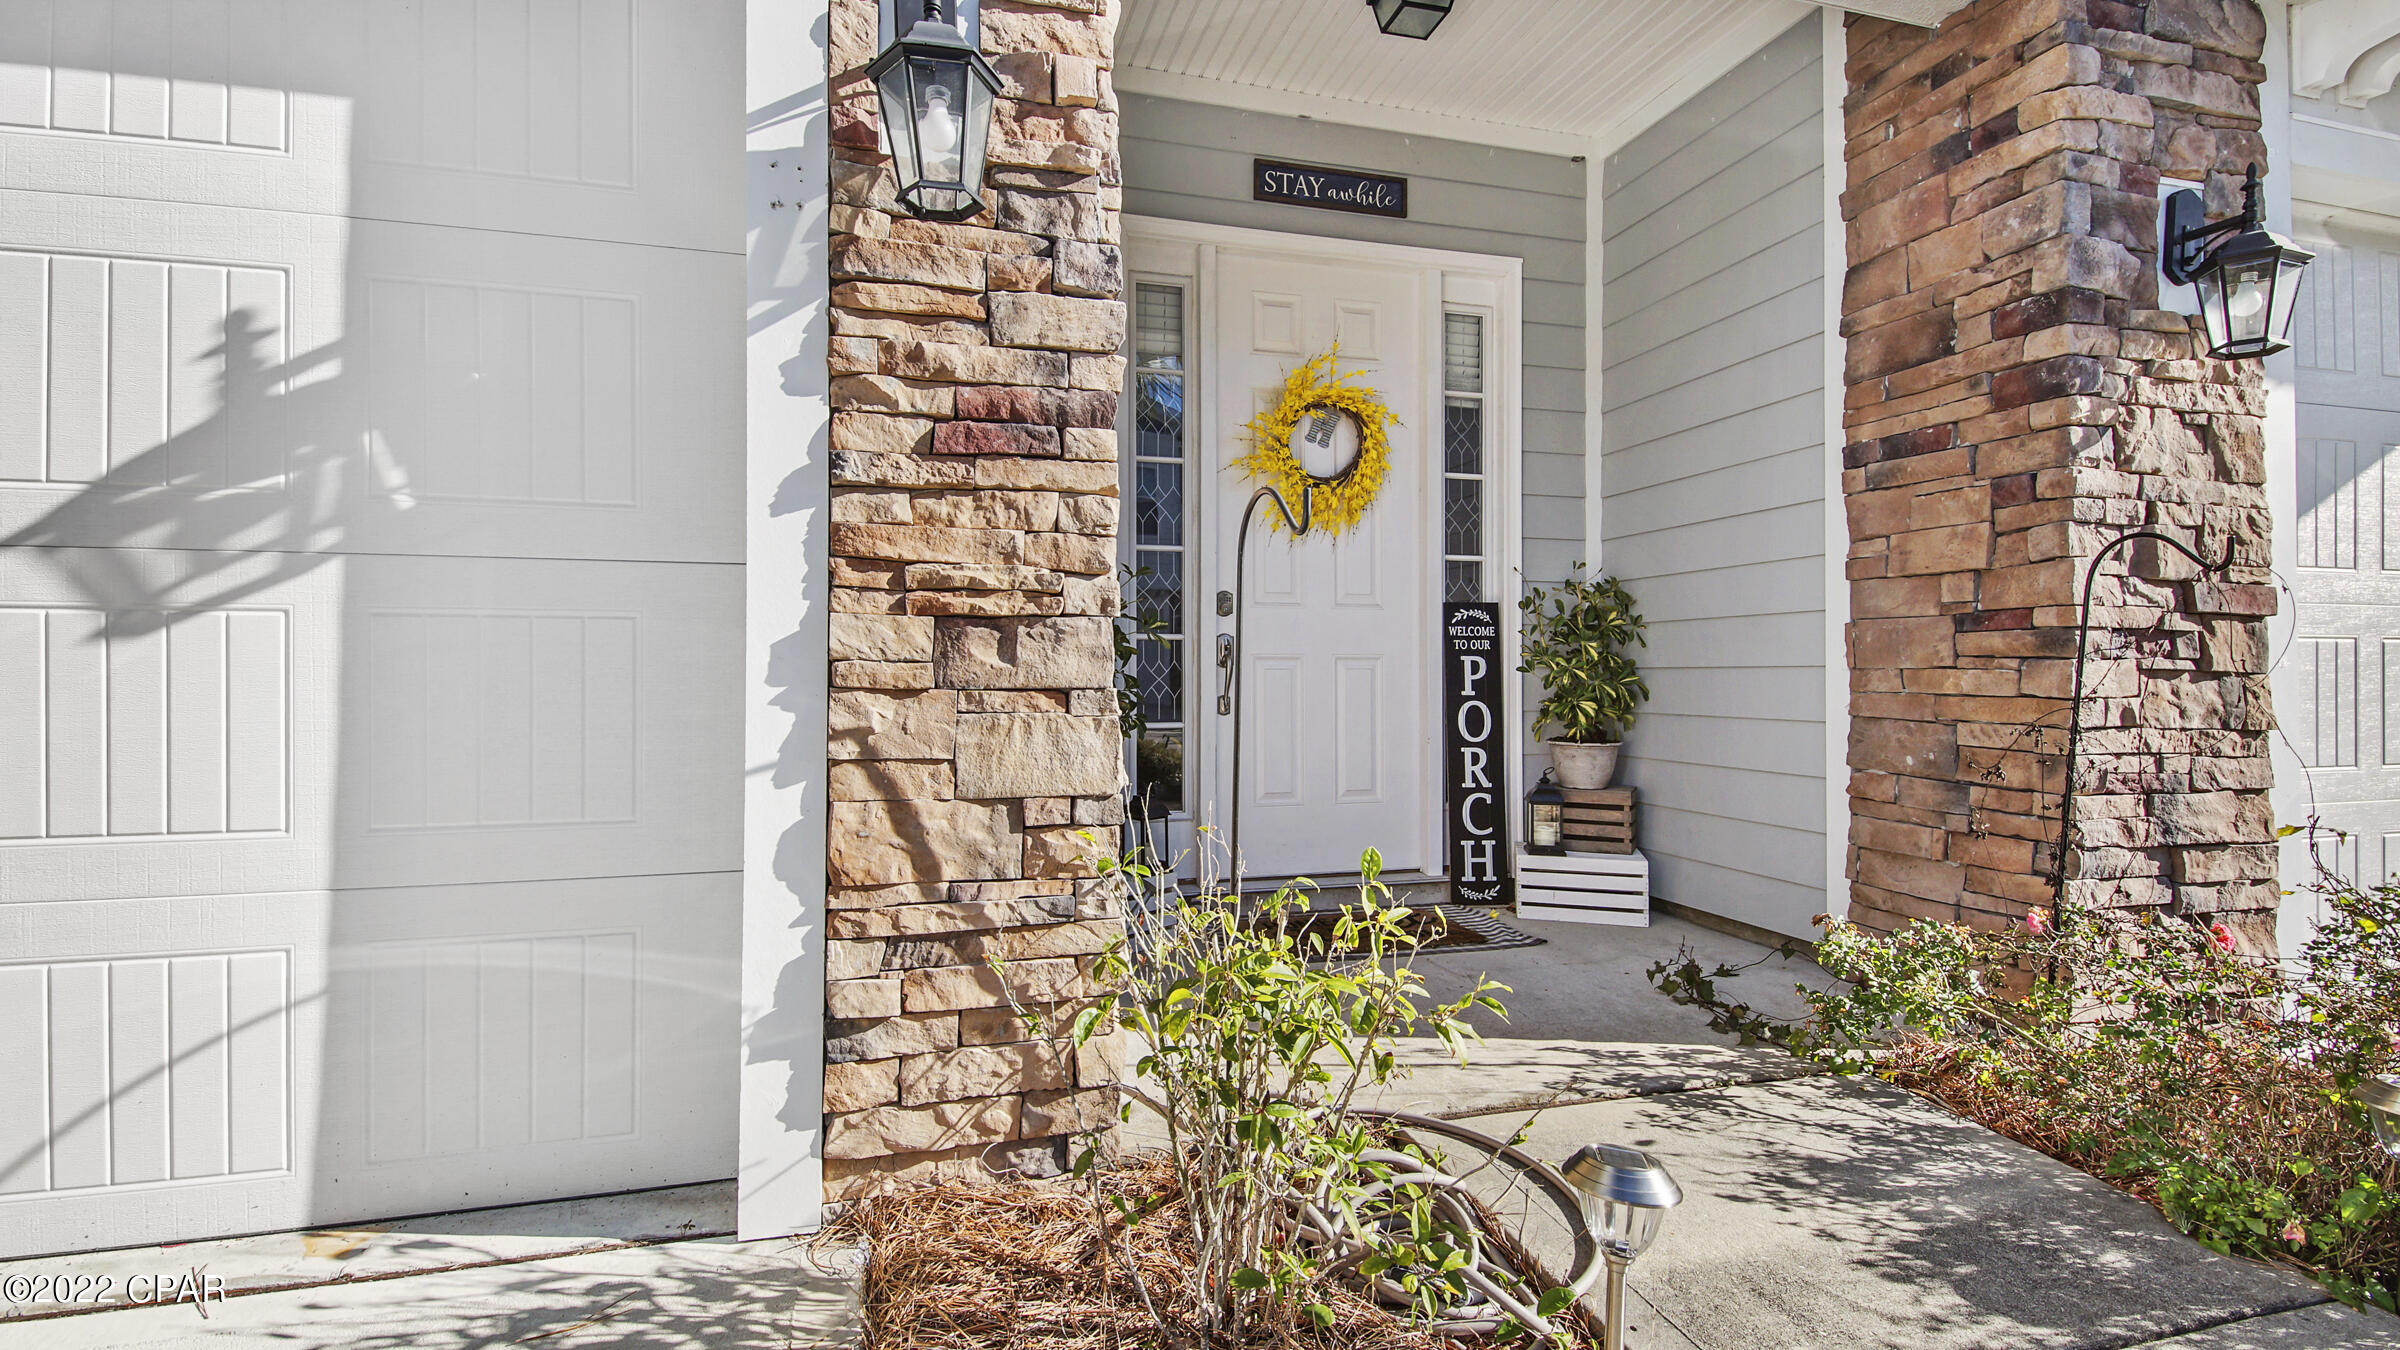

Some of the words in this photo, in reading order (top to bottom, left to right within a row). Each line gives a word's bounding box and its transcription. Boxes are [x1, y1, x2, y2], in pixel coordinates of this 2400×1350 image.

[1264, 170, 1326, 198] STAY
[1327, 180, 1397, 208] awhile
[1448, 626, 1496, 637] WELCOME
[1453, 639, 1468, 650] TO
[1470, 639, 1491, 650] OUR
[1457, 655, 1498, 882] PORCH
